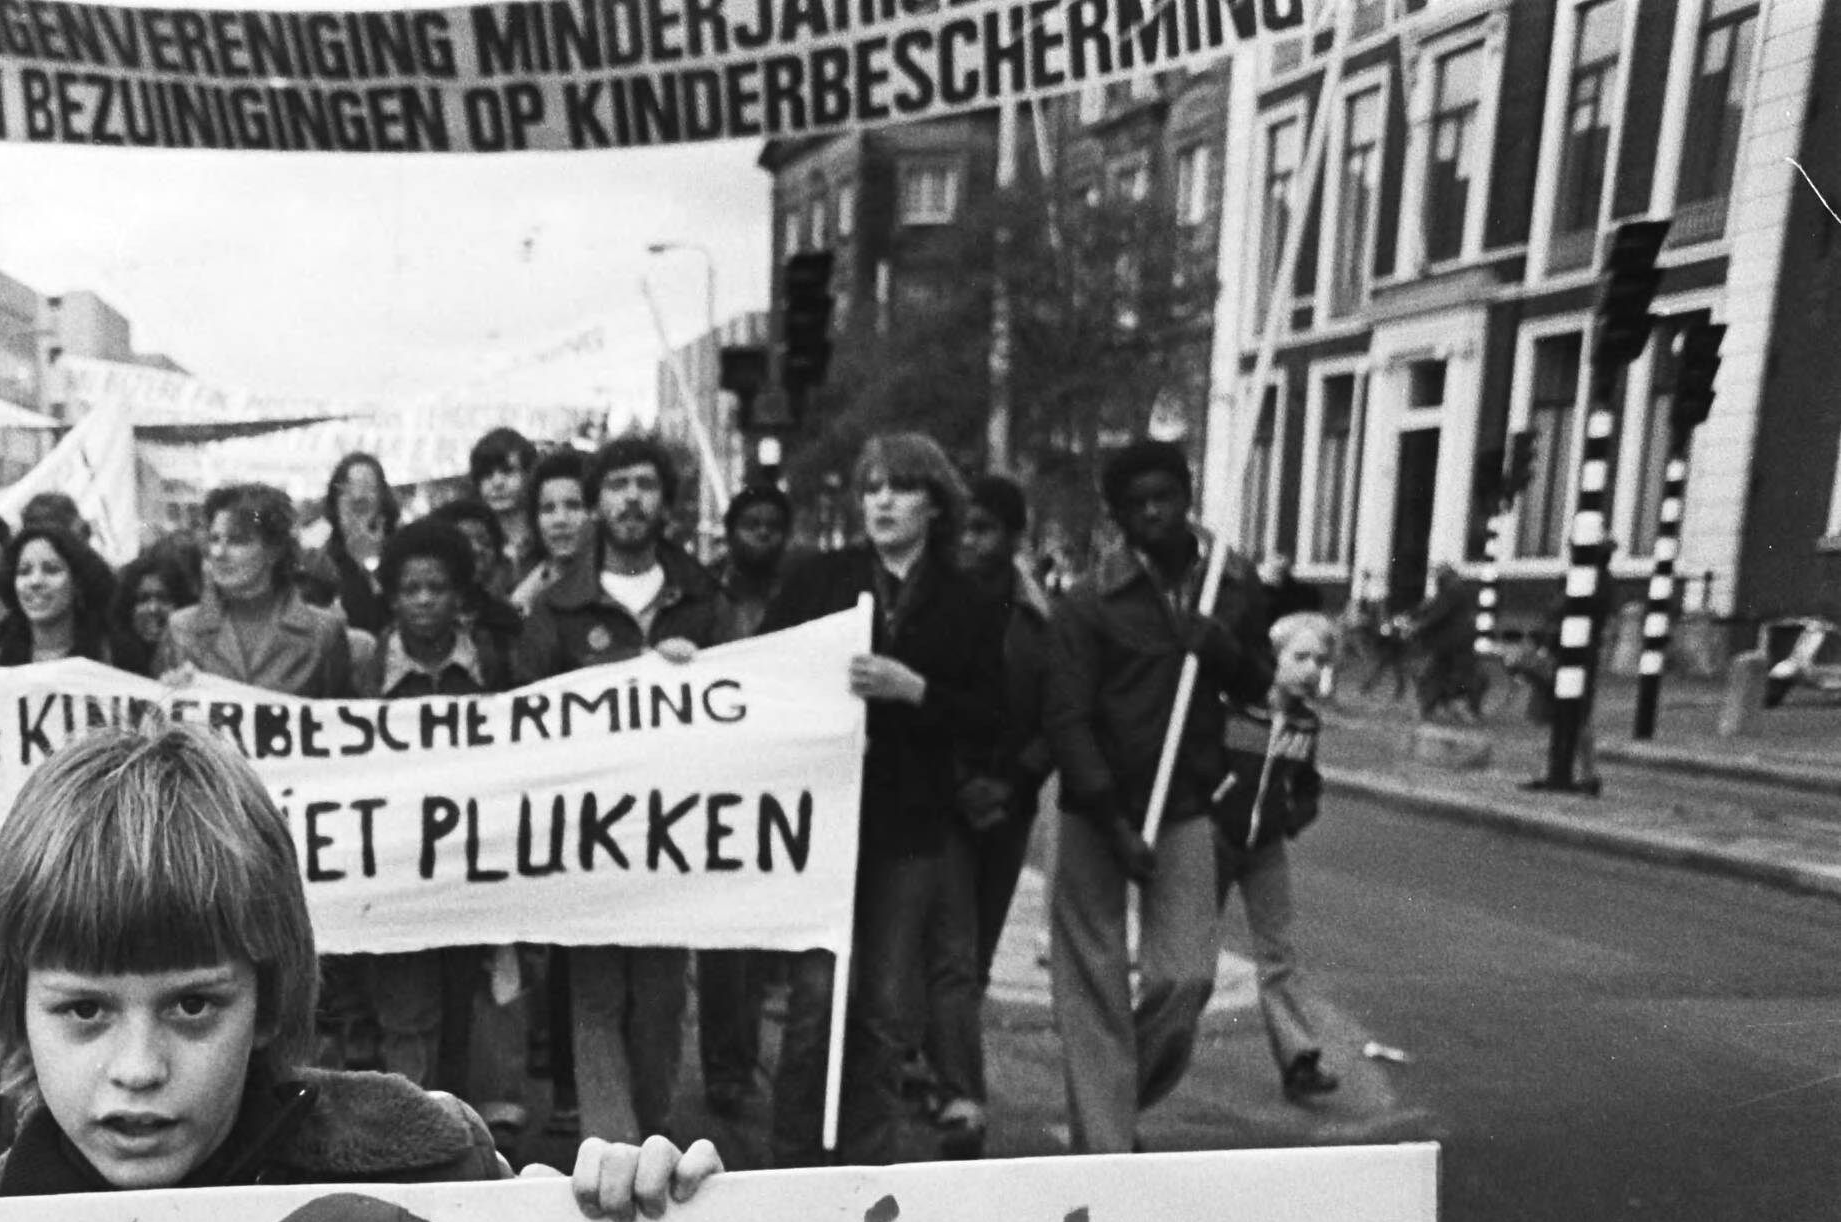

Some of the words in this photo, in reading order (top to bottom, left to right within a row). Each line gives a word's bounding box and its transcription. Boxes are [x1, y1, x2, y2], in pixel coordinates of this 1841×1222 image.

[21, 69, 450, 152] BEZUINIGINGEN
[464, 84, 543, 152] OP
[563, 0, 1305, 150] KINDERBESCHERMING
[419, 788, 813, 883] PLUKKEN
